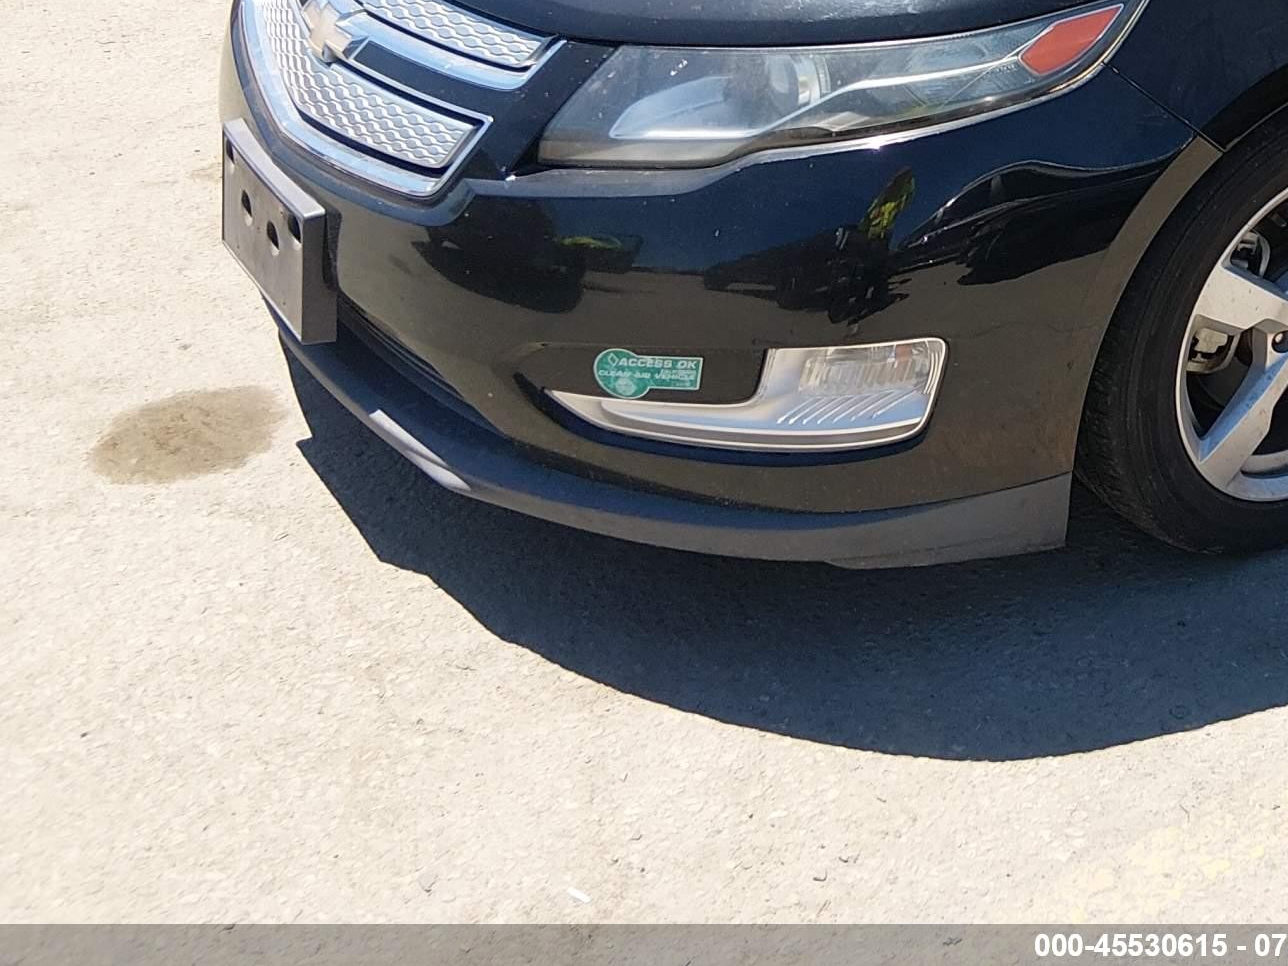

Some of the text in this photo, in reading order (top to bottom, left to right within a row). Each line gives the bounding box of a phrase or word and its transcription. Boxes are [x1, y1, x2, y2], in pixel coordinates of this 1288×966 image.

[618, 357, 698, 369] ACCESS OK
[598, 369, 632, 379] CLEAN
[634, 371, 651, 379] AIR
[655, 372, 695, 381] VEHICLE
